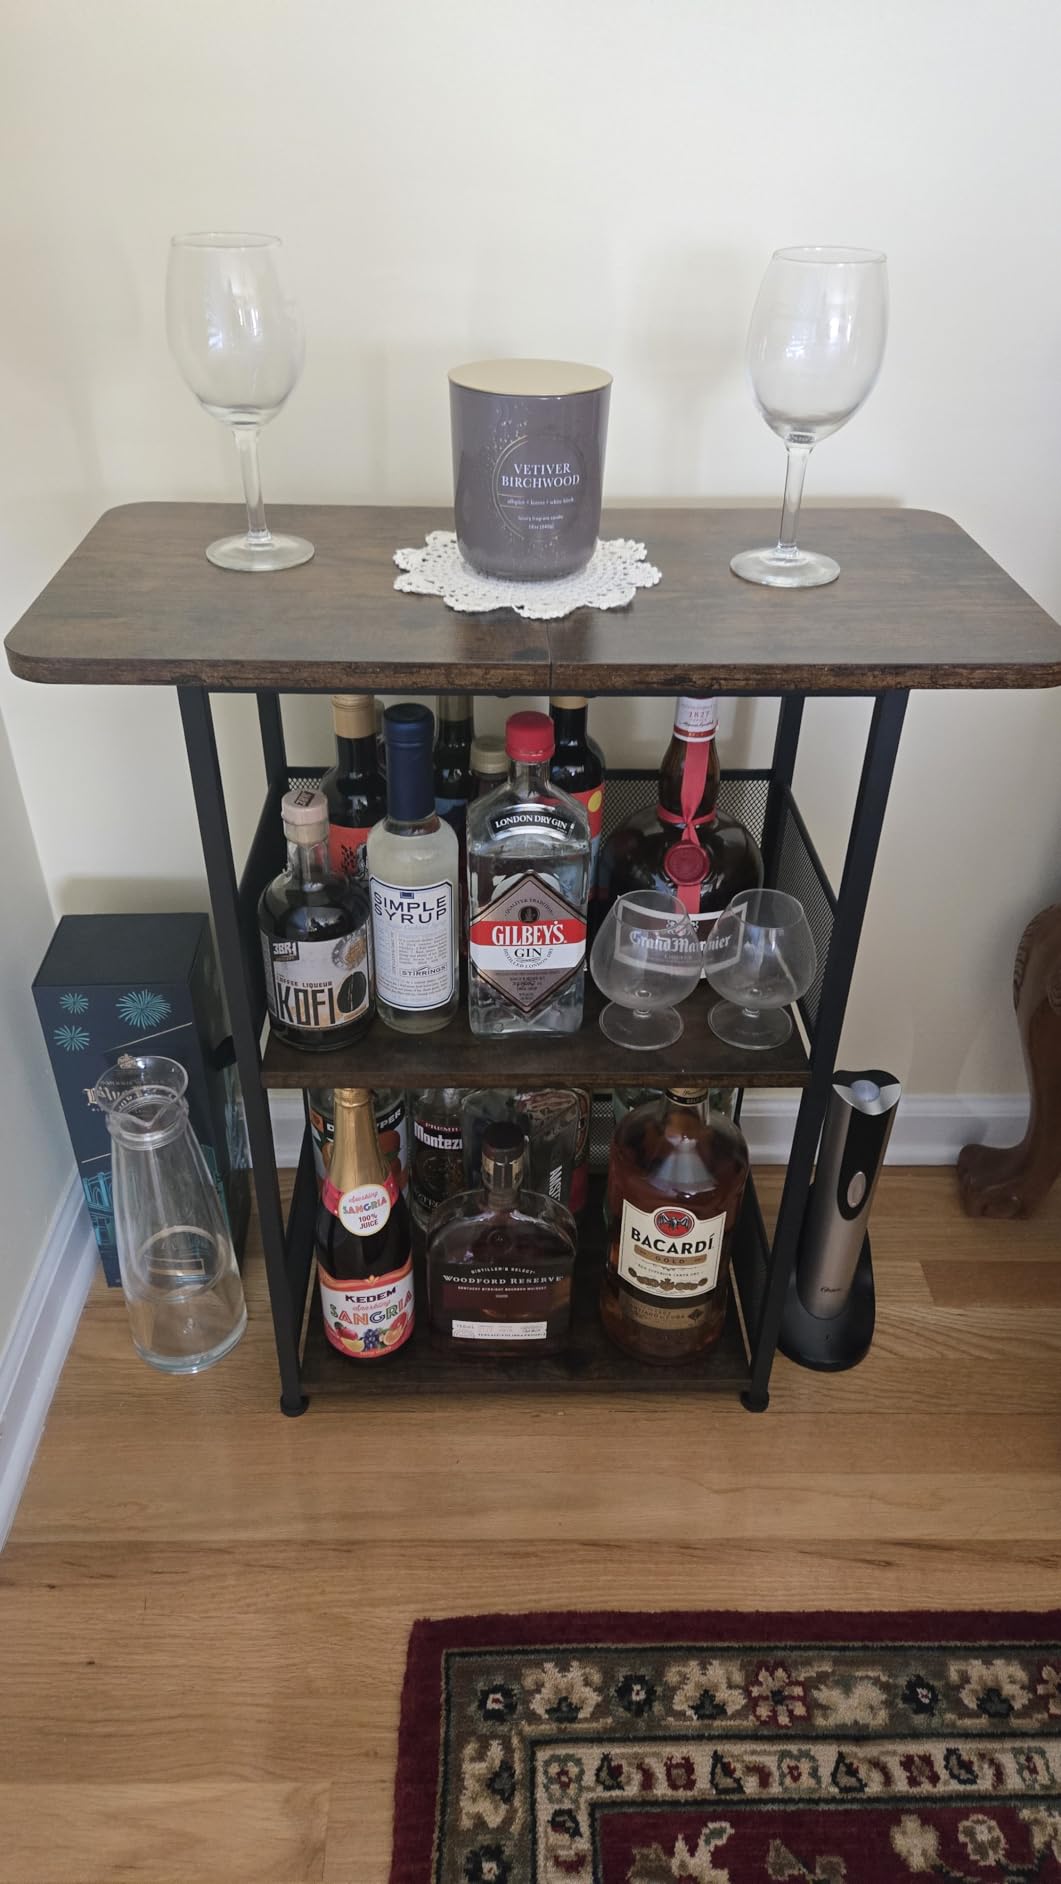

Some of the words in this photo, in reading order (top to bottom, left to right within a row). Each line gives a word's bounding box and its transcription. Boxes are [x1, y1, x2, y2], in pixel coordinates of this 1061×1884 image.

[514, 463, 570, 475] VETIVER
[502, 474, 580, 488] BIRCHWOOD
[495, 815, 533, 828] LONDON
[534, 815, 552, 824] DRY
[551, 818, 568, 829] GIN
[374, 892, 447, 912] SIMPLE
[374, 903, 447, 924] SYRUP
[492, 920, 565, 945] GILBEY'S
[629, 930, 671, 951] Grand
[671, 935, 732, 953] Marnier
[514, 947, 542, 958] GIN
[402, 965, 446, 976] STIRRINGS
[302, 981, 333, 989] LIQUEUR
[277, 982, 336, 1026] KOFI
[425, 1122, 459, 1132] PREMI
[414, 1121, 463, 1149] Montez
[342, 1196, 387, 1214] SANGRIA
[358, 1213, 378, 1223] 100%
[360, 1219, 378, 1230] JUICE
[631, 1226, 715, 1254] BACARDÍ
[655, 1255, 685, 1264] GOLD
[443, 1274, 507, 1285] WOODFORD
[510, 1276, 563, 1285] RESERVE
[345, 1286, 397, 1303] KEDEM
[330, 1290, 412, 1325] SANGRIA
